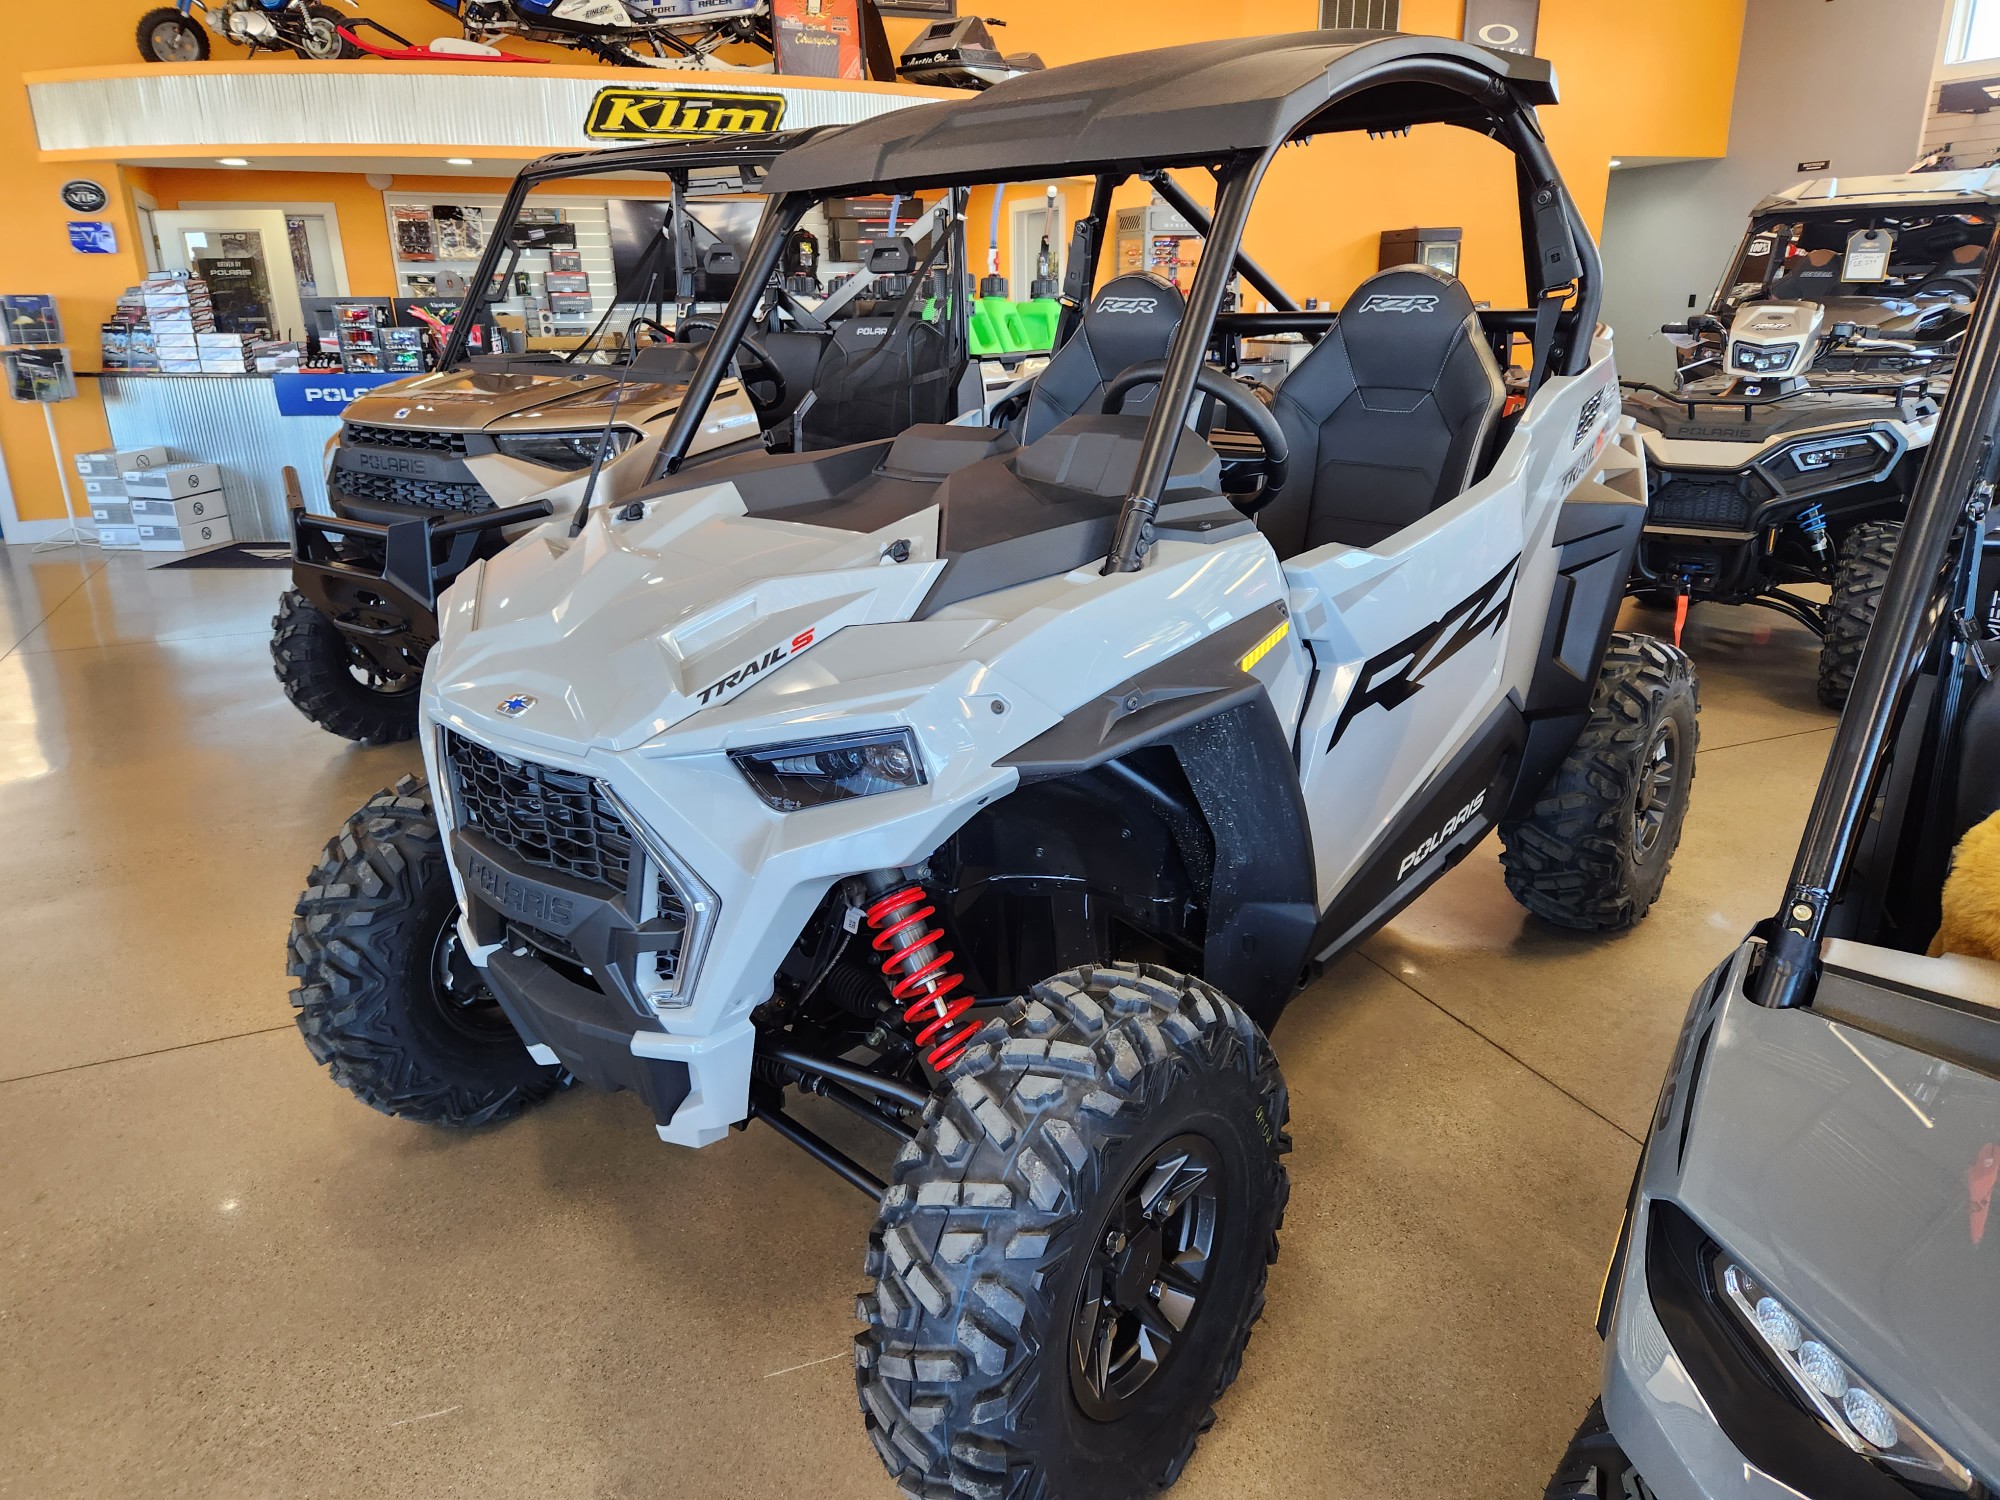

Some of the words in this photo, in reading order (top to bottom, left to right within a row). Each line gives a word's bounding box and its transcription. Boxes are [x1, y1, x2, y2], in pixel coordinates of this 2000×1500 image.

[933, 52, 949, 63] Cat
[71, 193, 97, 203] VIP
[1096, 297, 1158, 314] RZR
[1359, 294, 1440, 313] RZR
[1678, 426, 1753, 438] POLARIS
[360, 453, 425, 475] POLARIS
[697, 646, 788, 706] TRAIL
[1396, 787, 1487, 882] POLARIS
[468, 856, 574, 927] POLARIS
